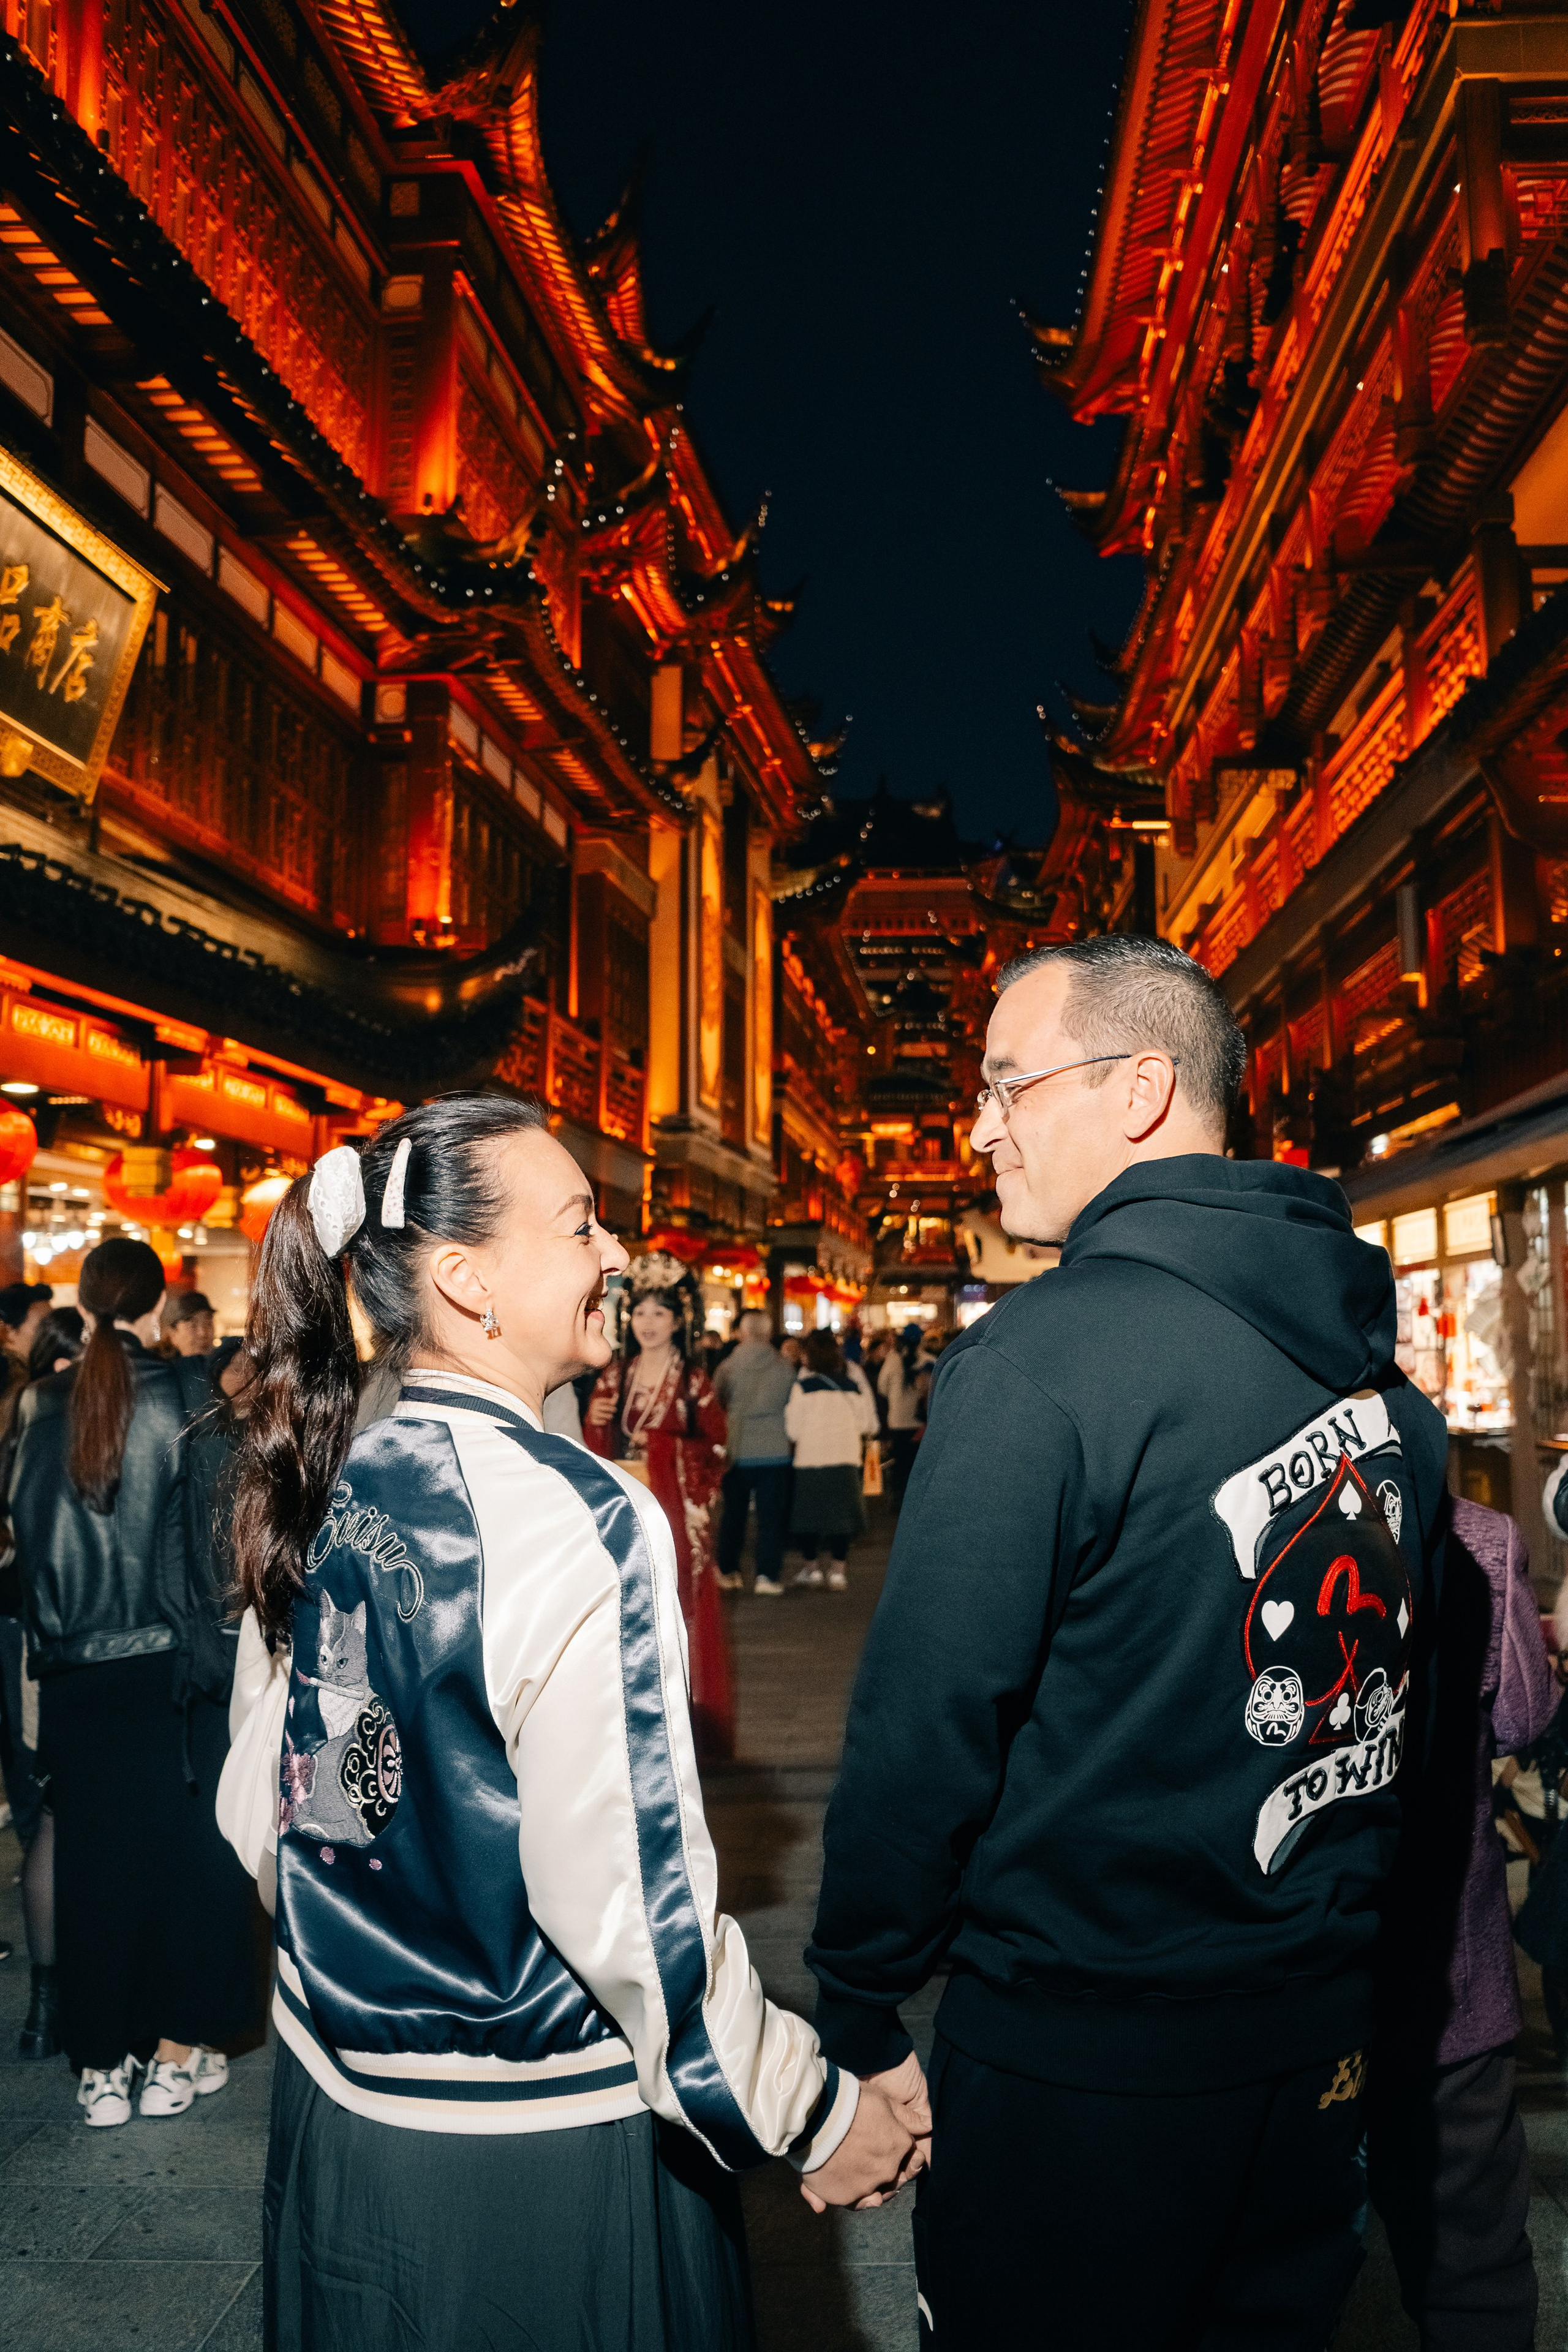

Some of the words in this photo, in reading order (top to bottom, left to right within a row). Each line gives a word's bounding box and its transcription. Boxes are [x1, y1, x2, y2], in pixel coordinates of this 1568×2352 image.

[1257, 1408, 1367, 1517] BORN
[1283, 1768, 1329, 1821] TO
[1335, 1717, 1404, 1794] WIN
